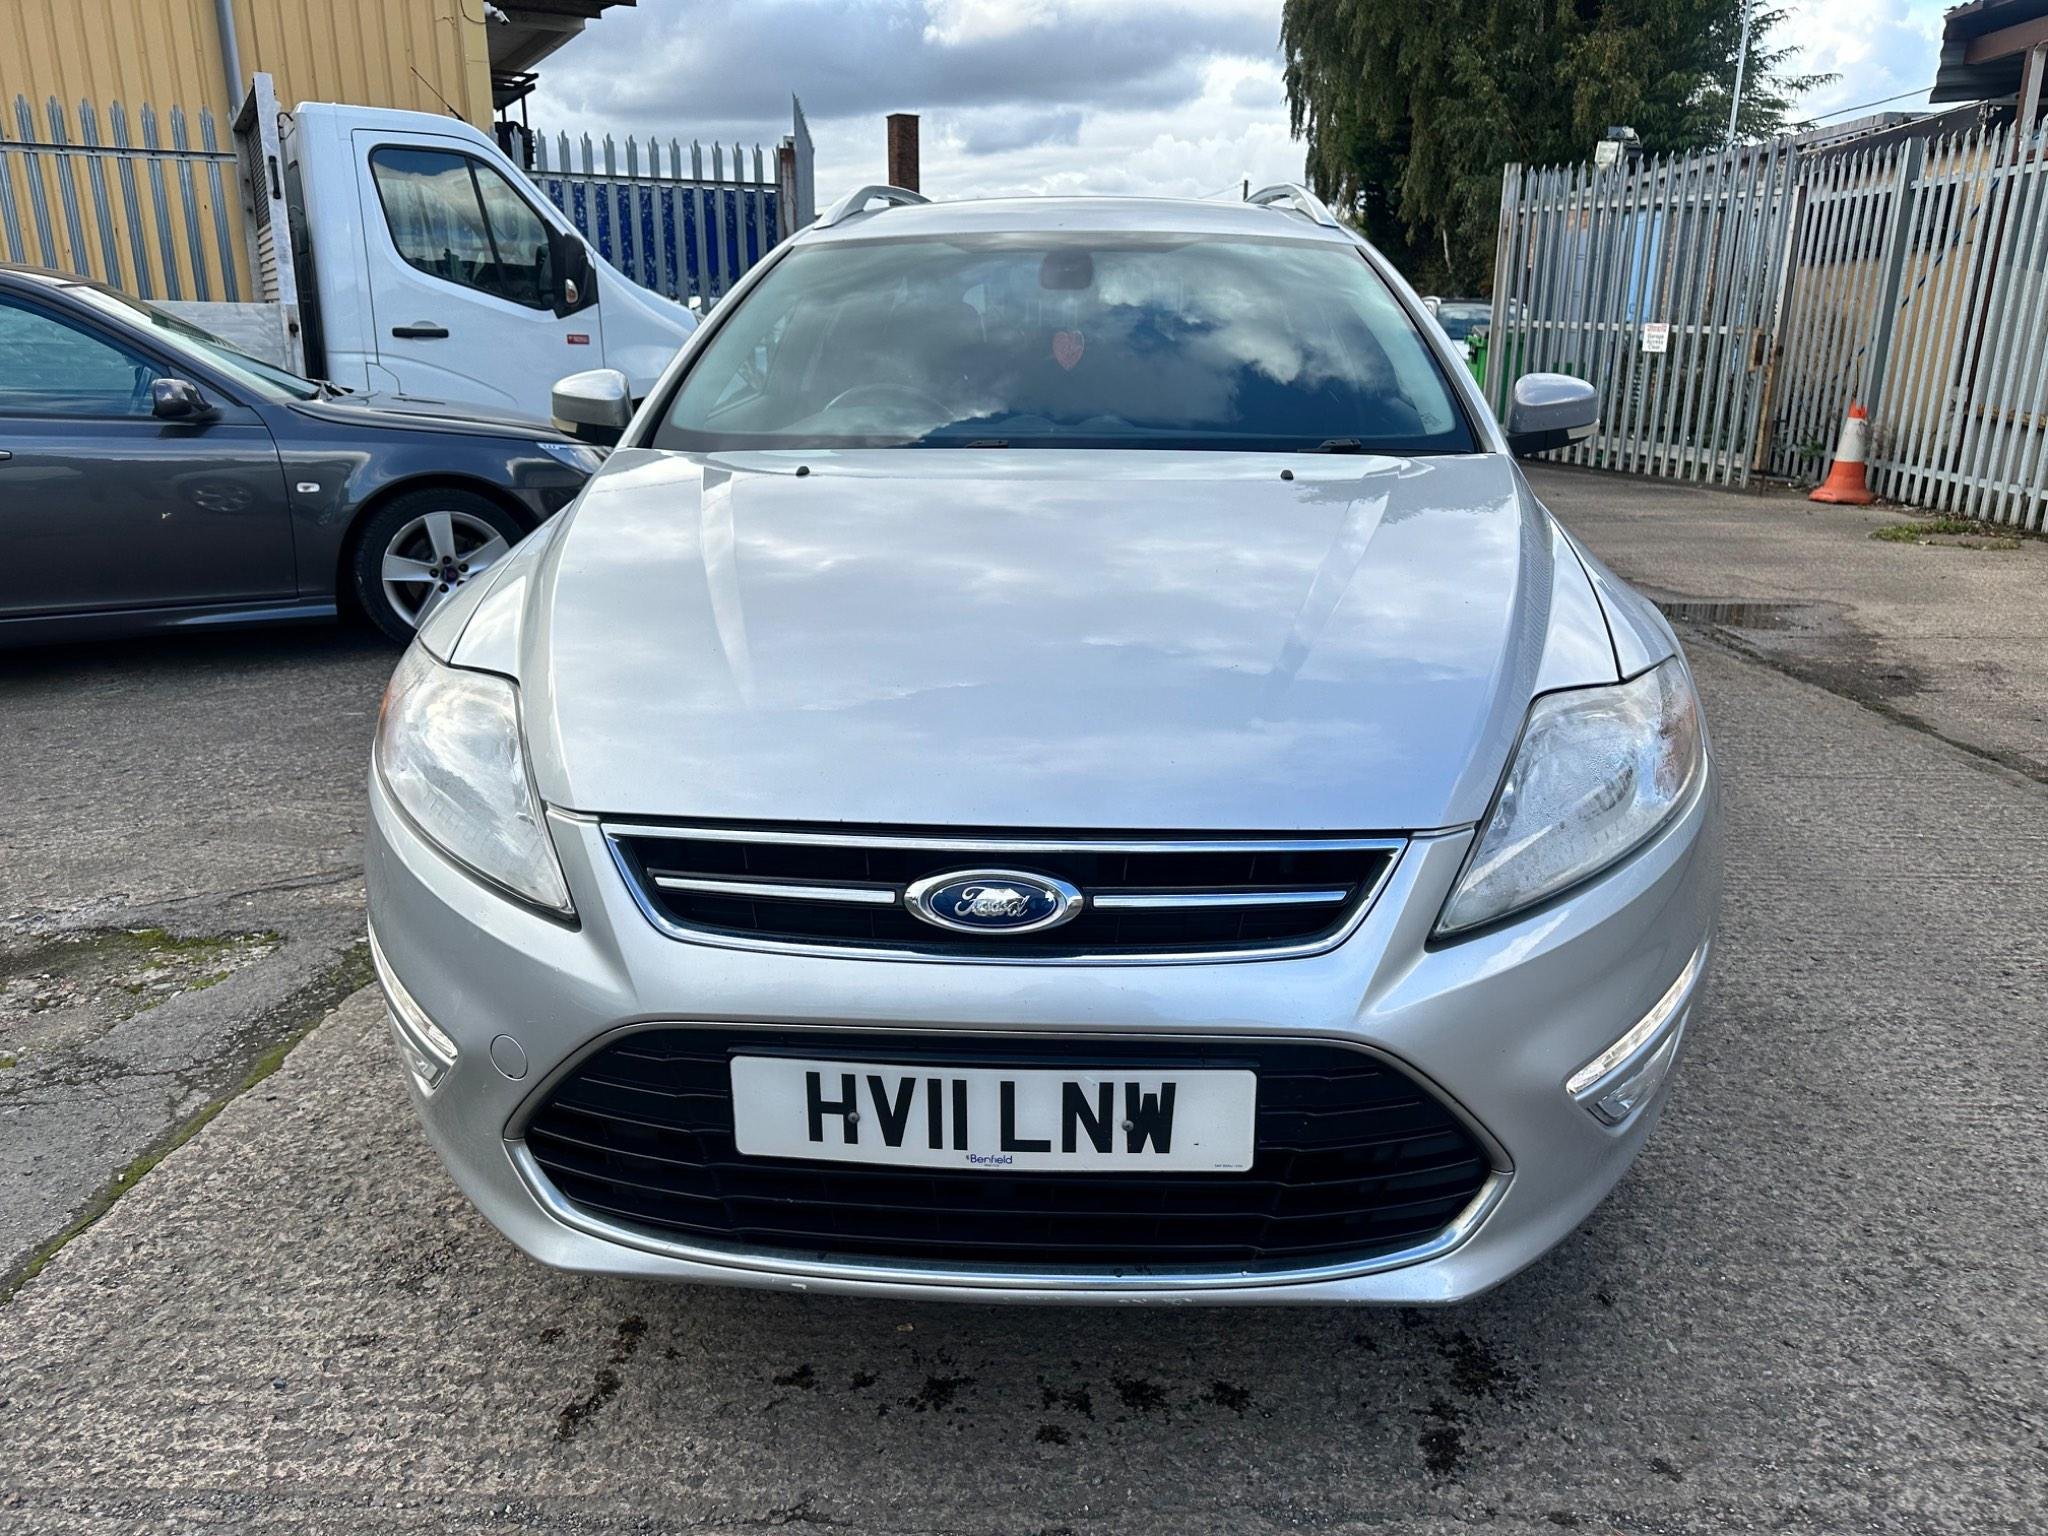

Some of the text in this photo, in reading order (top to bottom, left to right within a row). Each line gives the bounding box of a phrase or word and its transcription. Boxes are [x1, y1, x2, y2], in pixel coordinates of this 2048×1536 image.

[954, 886, 1031, 918] Ford
[806, 1071, 1177, 1153] HV11 LNW
[970, 1153, 1013, 1164] Benfield
